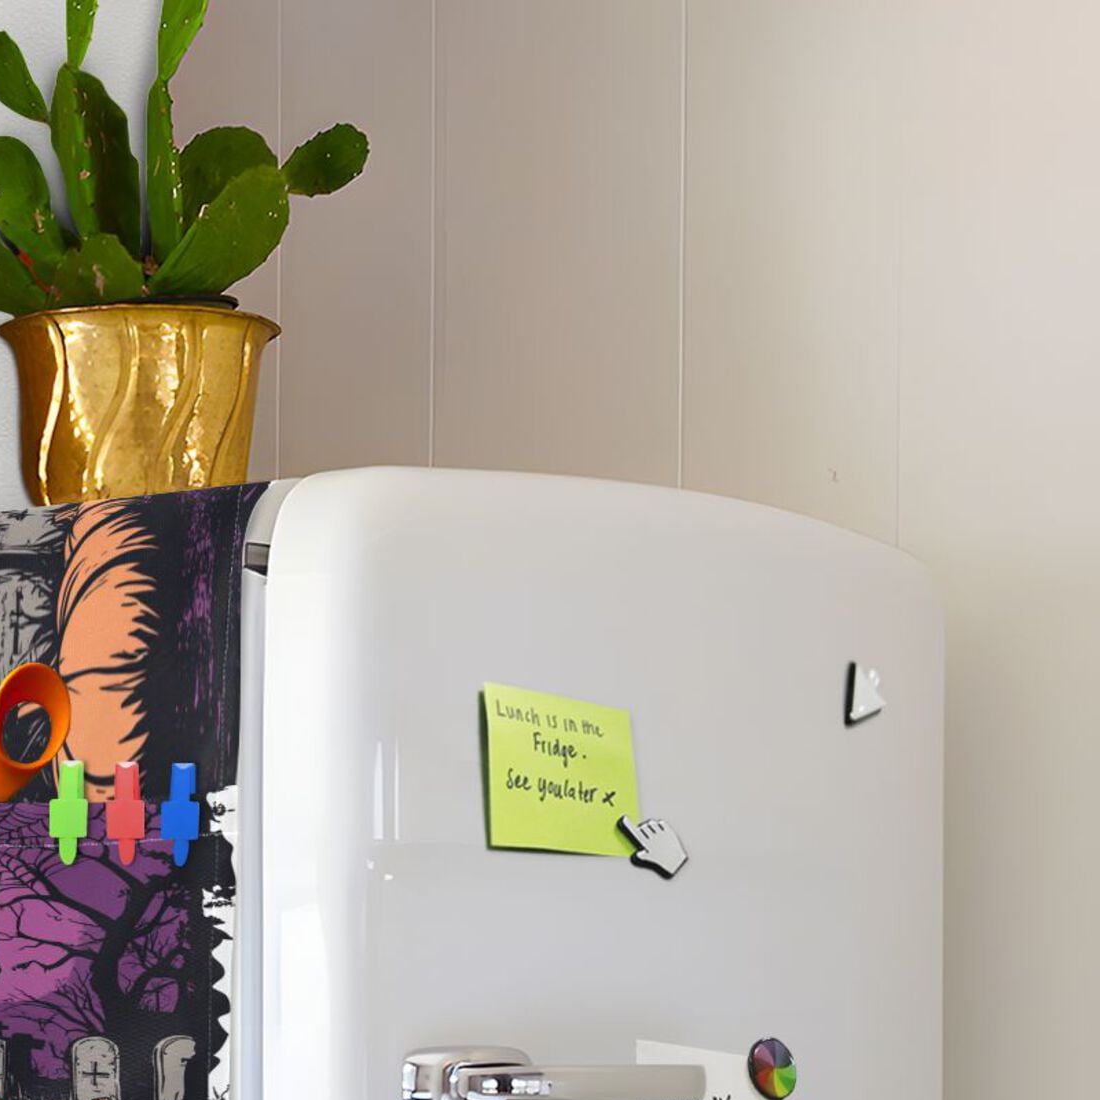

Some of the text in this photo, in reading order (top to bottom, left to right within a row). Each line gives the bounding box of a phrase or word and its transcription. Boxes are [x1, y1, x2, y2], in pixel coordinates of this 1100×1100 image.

[495, 699, 541, 727] Lunch
[582, 719, 604, 738] the
[506, 768, 532, 791] See
